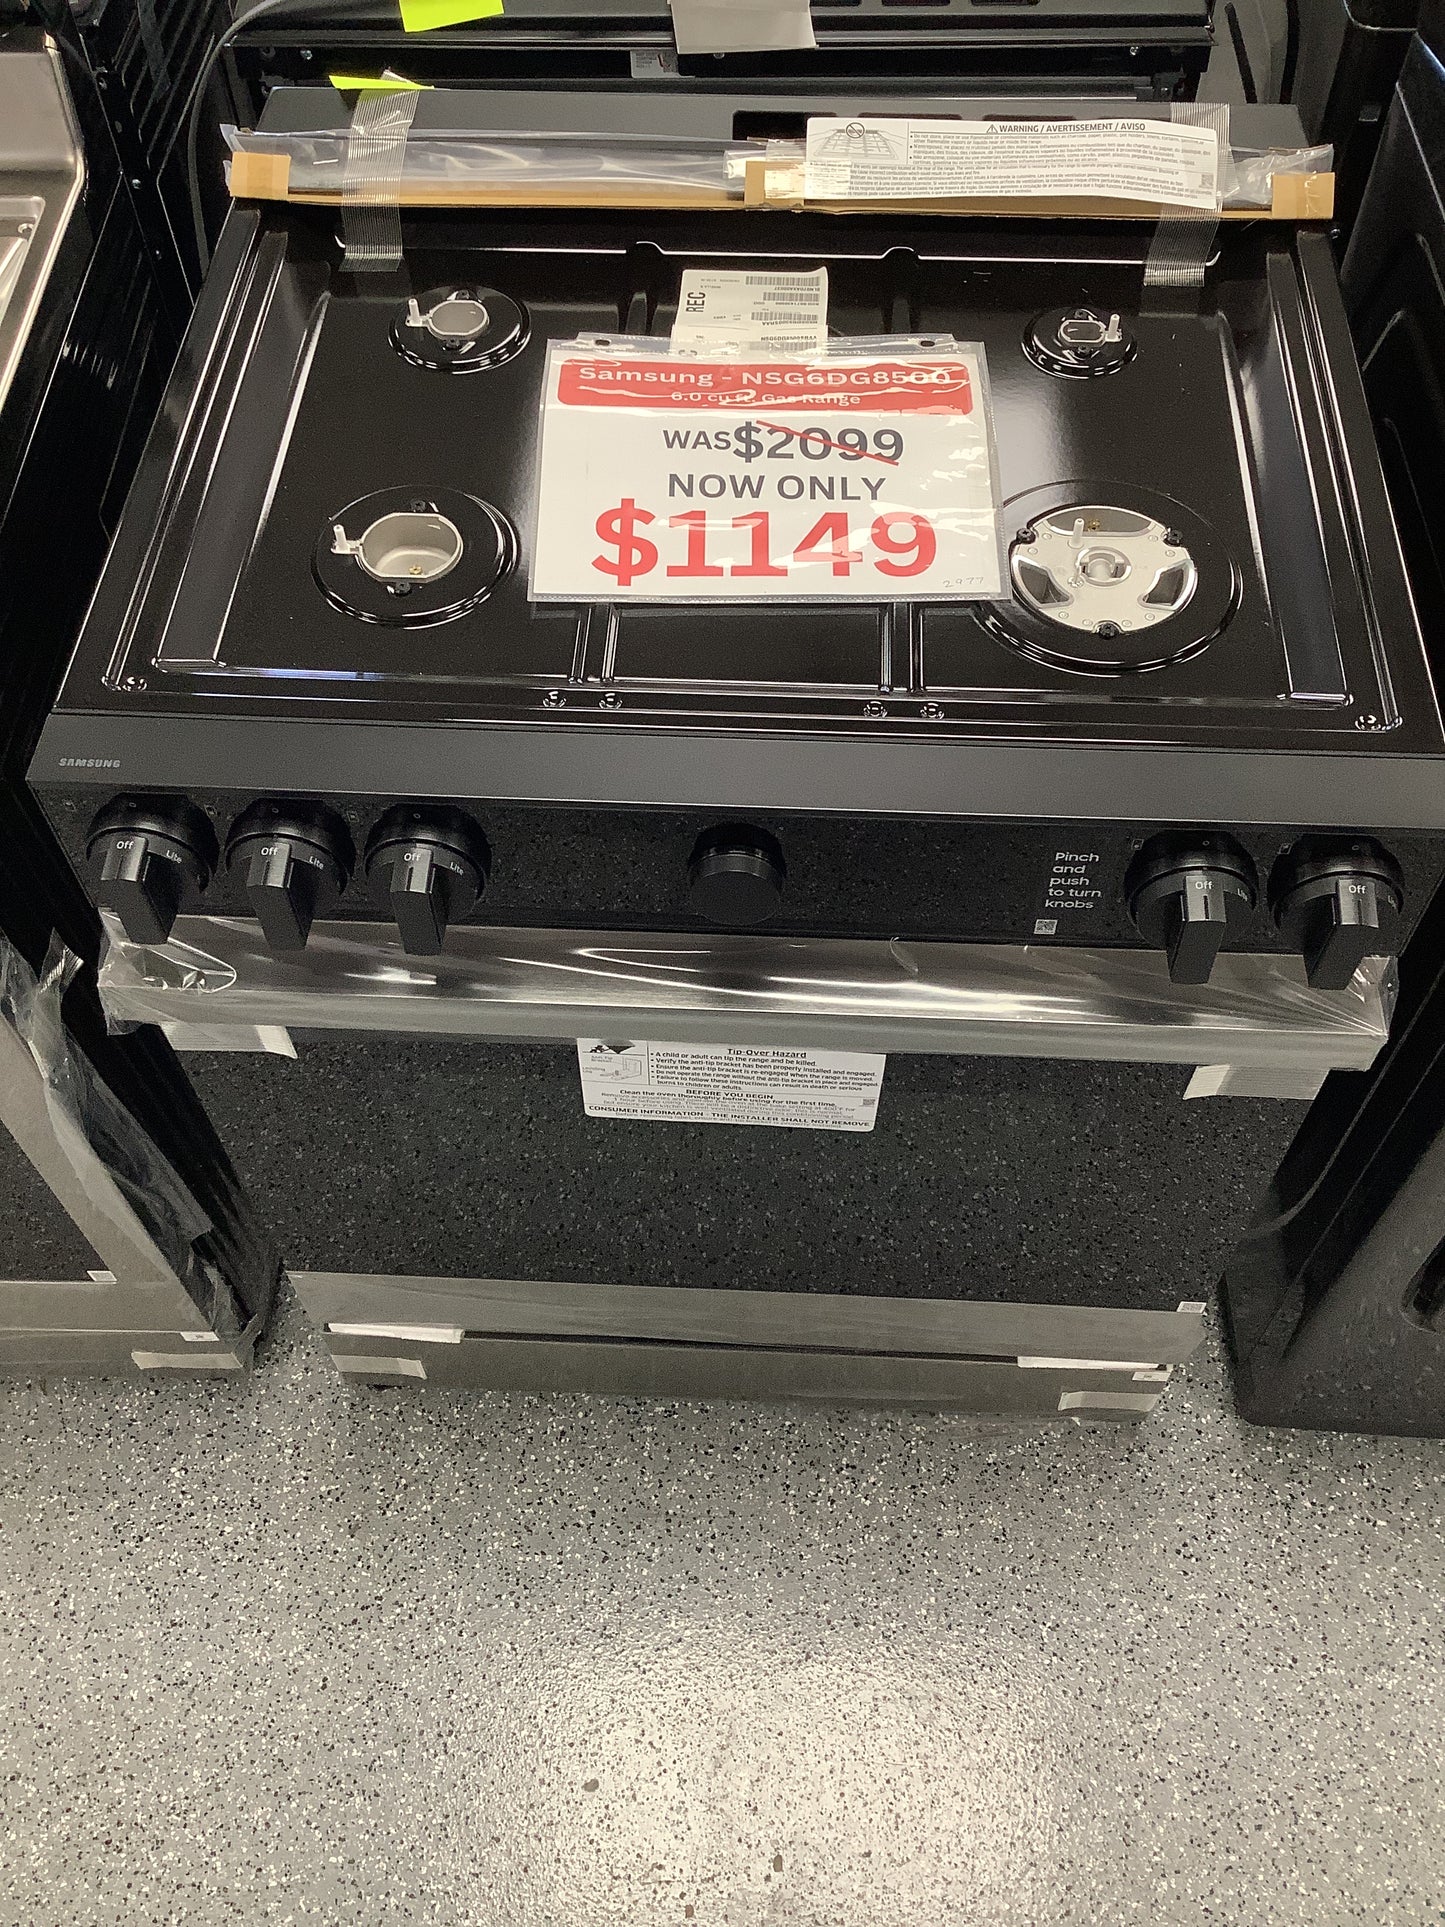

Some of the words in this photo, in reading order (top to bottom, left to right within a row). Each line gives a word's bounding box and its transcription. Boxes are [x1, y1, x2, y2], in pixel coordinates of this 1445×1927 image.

[1040, 124, 1045, 134] /
[1046, 122, 1113, 132] AVERTISSEMENT
[1115, 122, 1119, 131] /
[1120, 122, 1146, 131] AVISO
[686, 292, 706, 312] REC
[579, 367, 714, 387] Samsung
[742, 371, 951, 386] NSG6DG8500
[670, 391, 702, 402] 6.0
[761, 394, 797, 404] Gas
[801, 394, 861, 407] Range
[668, 473, 765, 499] NOW
[777, 475, 886, 501] ONLY
[591, 498, 937, 587] $1149
[943, 576, 985, 588] 2977
[58, 757, 121, 768] SAMSUNG
[116, 840, 134, 850] Off
[166, 849, 183, 864] Lite
[1055, 852, 1100, 862] Pinch
[260, 847, 278, 857] Off
[308, 855, 325, 870] Lite
[403, 851, 421, 862] Off
[449, 861, 464, 876] Lite
[1052, 865, 1086, 874] and
[1049, 876, 1090, 887] push
[1195, 880, 1213, 890] Off
[1048, 888, 1065, 897] to
[1069, 889, 1102, 898] turn
[1348, 884, 1366, 894] Off
[1045, 899, 1094, 909] knobs
[727, 1048, 769, 1056] Tip-Over
[772, 1050, 807, 1059] Hazard
[803, 1066, 831, 1074] installed
[678, 1093, 720, 1101] thoroughly
[686, 1089, 721, 1097] BEFORE
[589, 1105, 638, 1114] CONSUMER
[640, 1109, 704, 1117] INFORMATION
[731, 1114, 779, 1122] INSTALLER
